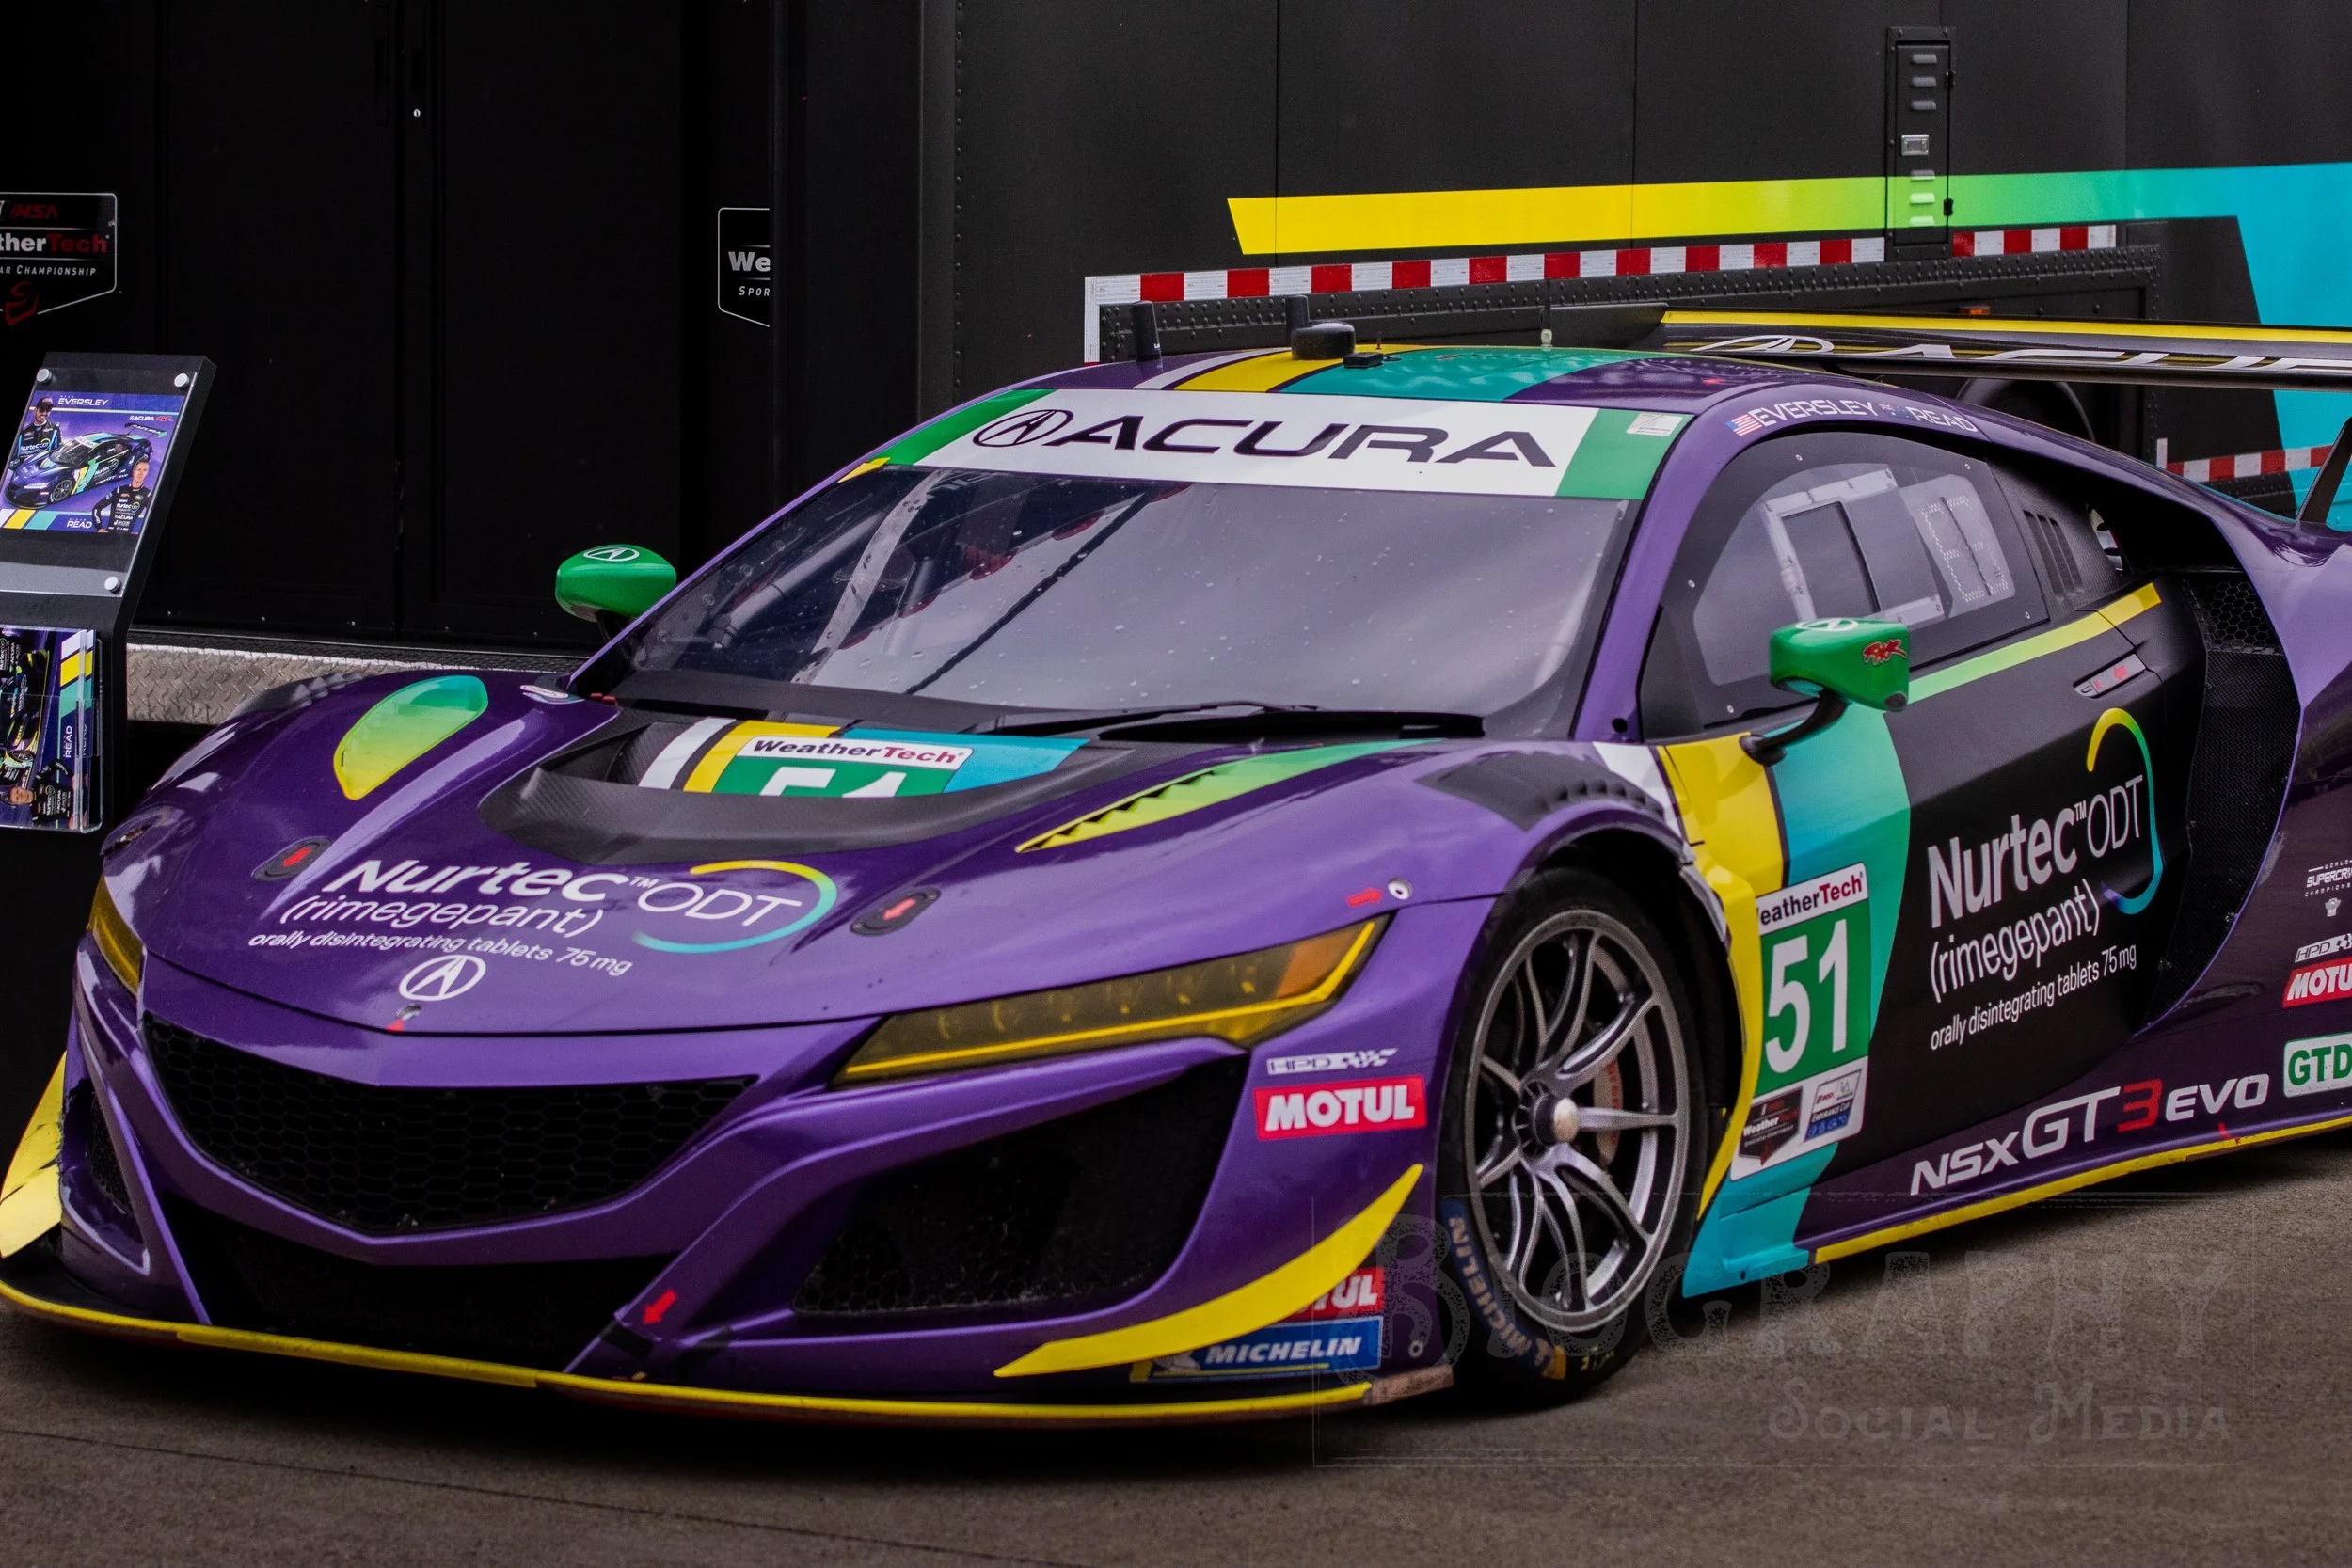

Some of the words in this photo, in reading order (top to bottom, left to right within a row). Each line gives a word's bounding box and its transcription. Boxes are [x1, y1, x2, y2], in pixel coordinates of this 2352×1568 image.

[16, 265, 96, 276] CHAMPIONSHIP
[739, 286, 770, 296] SPOR
[58, 397, 108, 406] EVERSLEY
[1747, 399, 1879, 427] EVERSLEY
[1905, 406, 1978, 433] READ
[1057, 414, 1558, 468] ACURA
[67, 520, 92, 529] READ
[753, 738, 958, 766] WeatherTech
[2087, 774, 2143, 858] ODT
[280, 895, 604, 938] (rimegepant)
[638, 882, 802, 927] ODT
[1757, 876, 1863, 926] eatherTech
[248, 931, 313, 949] orally
[310, 930, 465, 953] disintegrating
[466, 935, 553, 960] tablets
[555, 946, 596, 967] 75
[588, 956, 633, 977] mg
[1931, 878, 2100, 1004] (rimegepant)
[1765, 918, 1848, 1074] 51
[1931, 1013, 1966, 1051] orally
[1968, 980, 2055, 1034] disintegrating
[2057, 961, 2099, 997] tablets
[2101, 945, 2118, 977] 75
[2118, 944, 2137, 973] mg
[2288, 1043, 2352, 1087] GTD
[1264, 1084, 1416, 1132] MOTUL
[1206, 1336, 1362, 1364] MICHELIN
